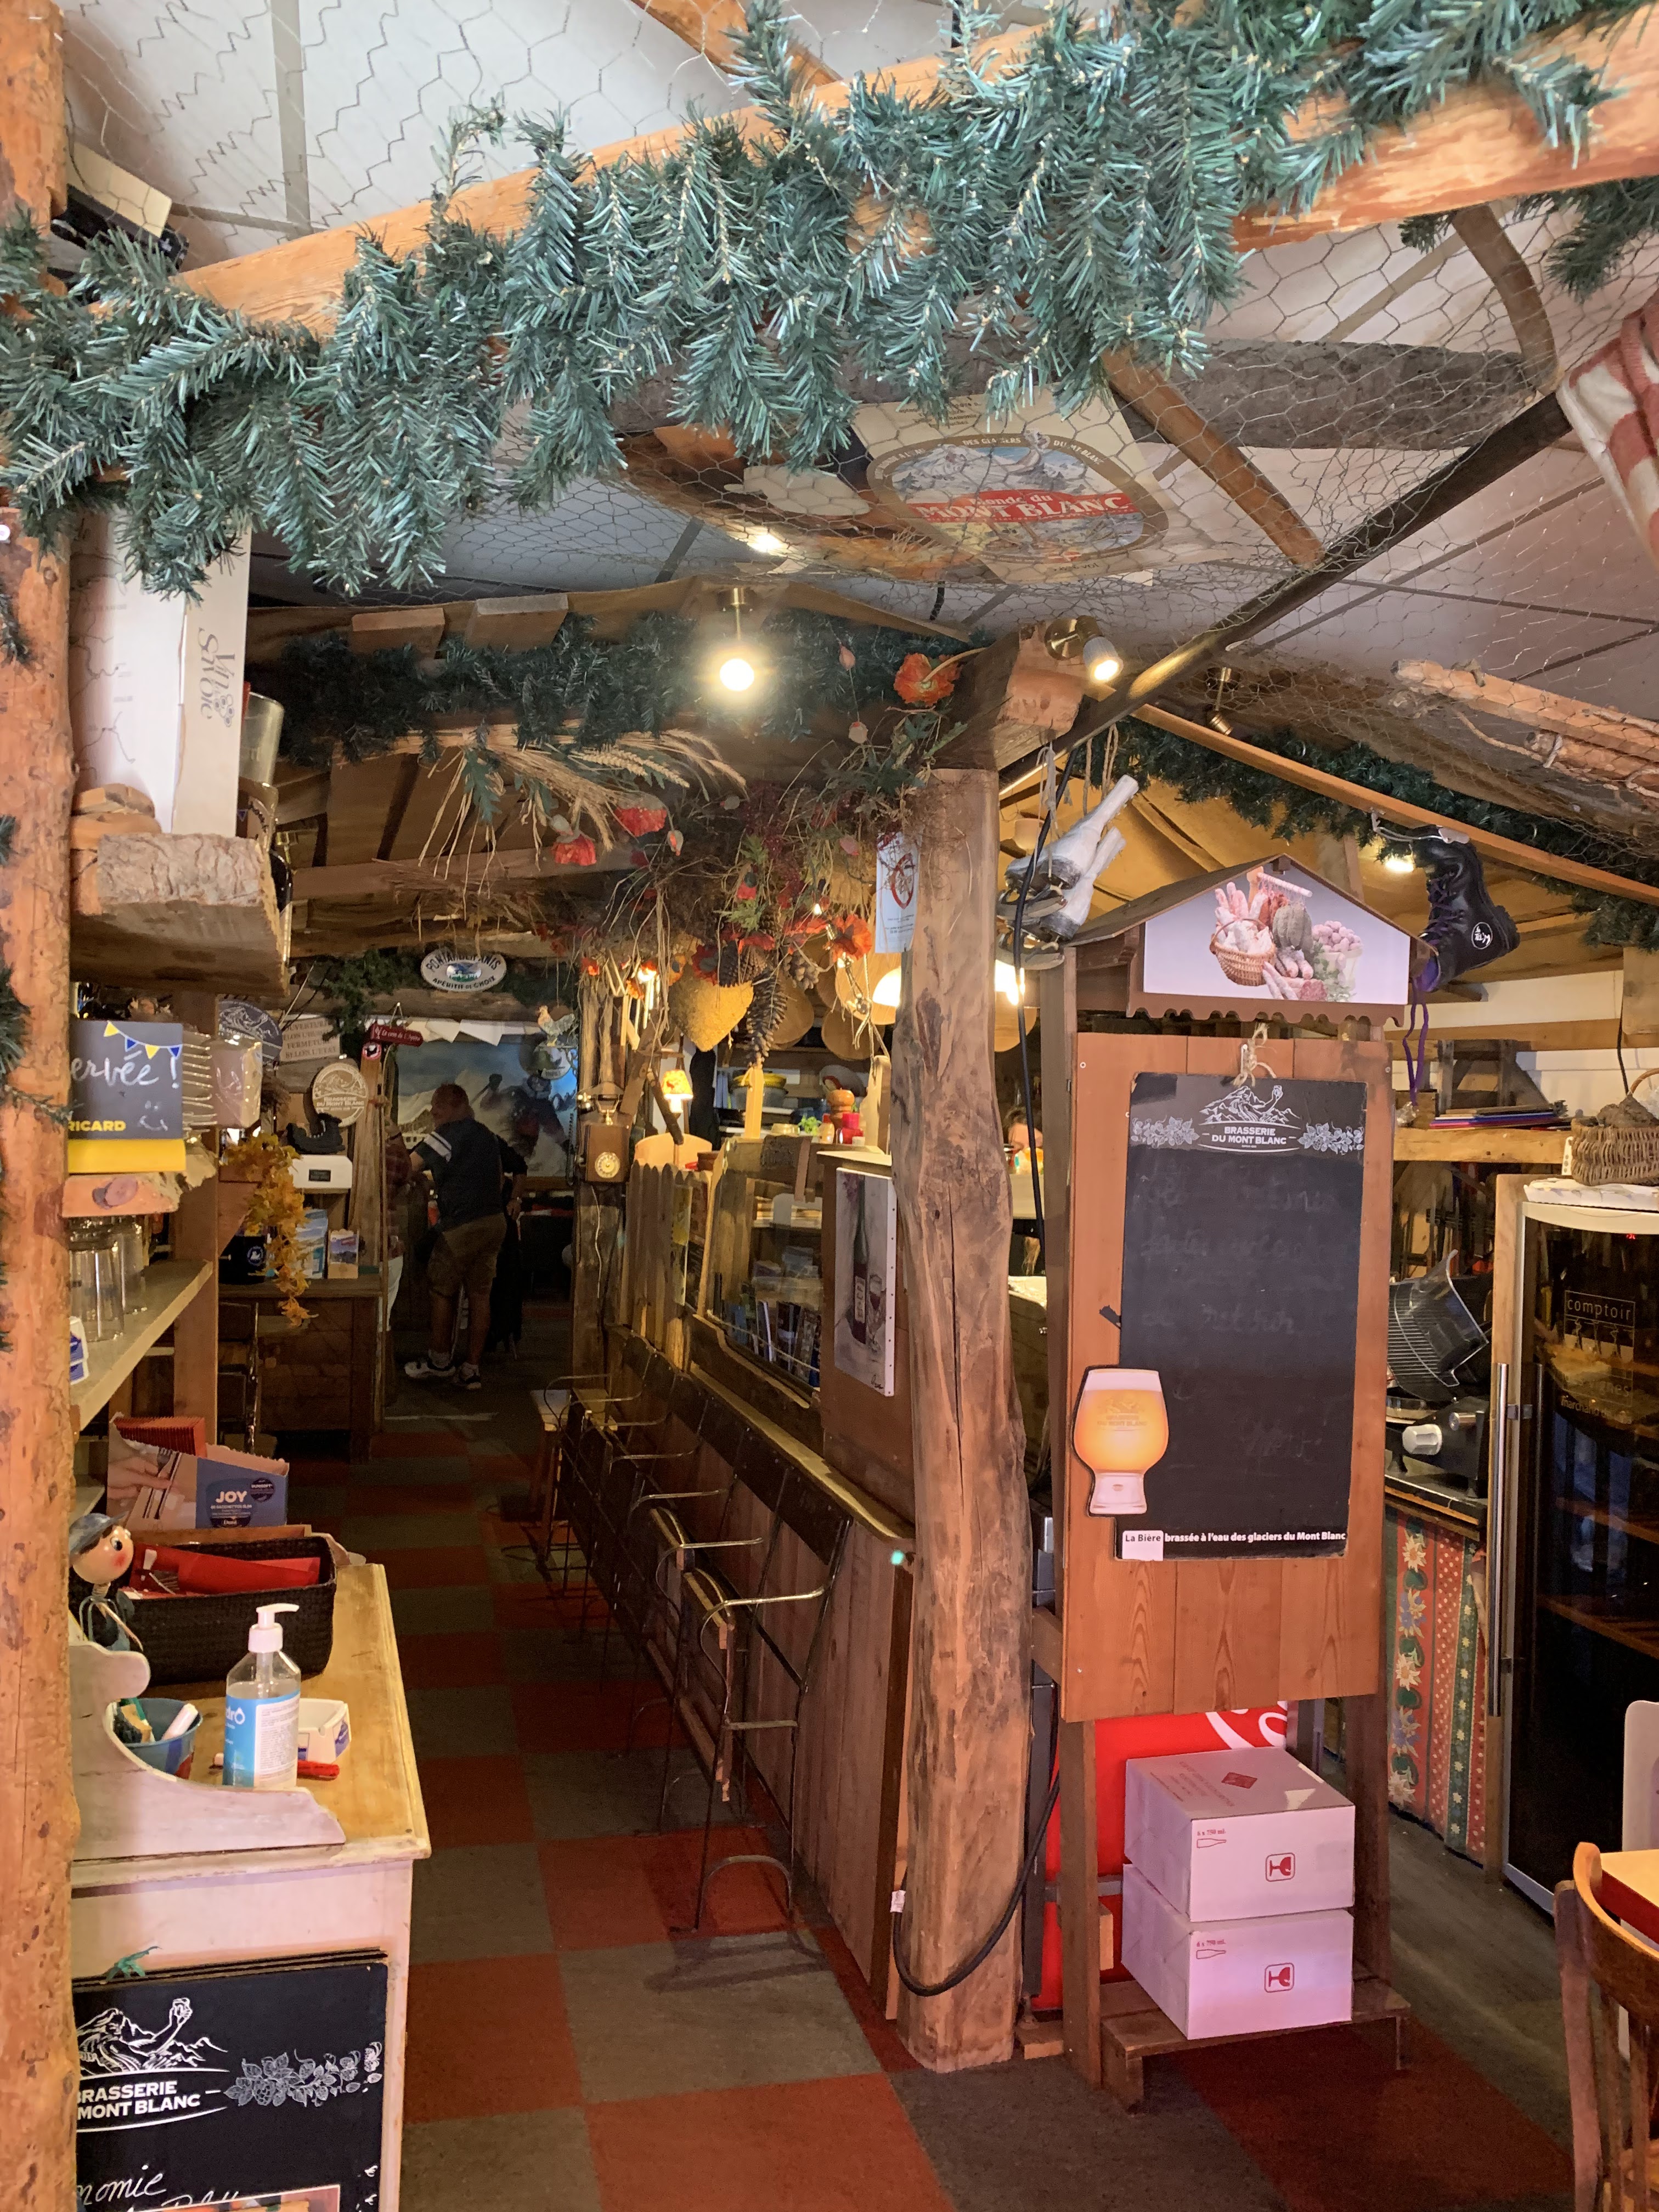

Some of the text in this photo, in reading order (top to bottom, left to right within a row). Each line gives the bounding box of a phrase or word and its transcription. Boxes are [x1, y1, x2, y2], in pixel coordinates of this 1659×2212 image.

[916, 496, 1129, 518] MONT BLANC
[68, 1120, 127, 1132] RICARD
[1224, 1126, 1276, 1136] BRASSERIE
[1211, 1135, 1287, 1145] DU MONT BLANC
[1567, 1299, 1632, 1320] comptoir
[215, 1491, 247, 1503] JOY
[1138, 1533, 1161, 1542] Bière
[1165, 1533, 1200, 1542] brassée
[1200, 1532, 1206, 1542] à
[1208, 1533, 1229, 1542] l'eau
[1231, 1532, 1246, 1542] des
[1248, 1532, 1282, 1543] glaciers
[1283, 1532, 1295, 1541] du
[1296, 1532, 1320, 1541] Mont
[1321, 1531, 1346, 1540] Blanc
[77, 2094, 201, 2120] MONT BLANC
